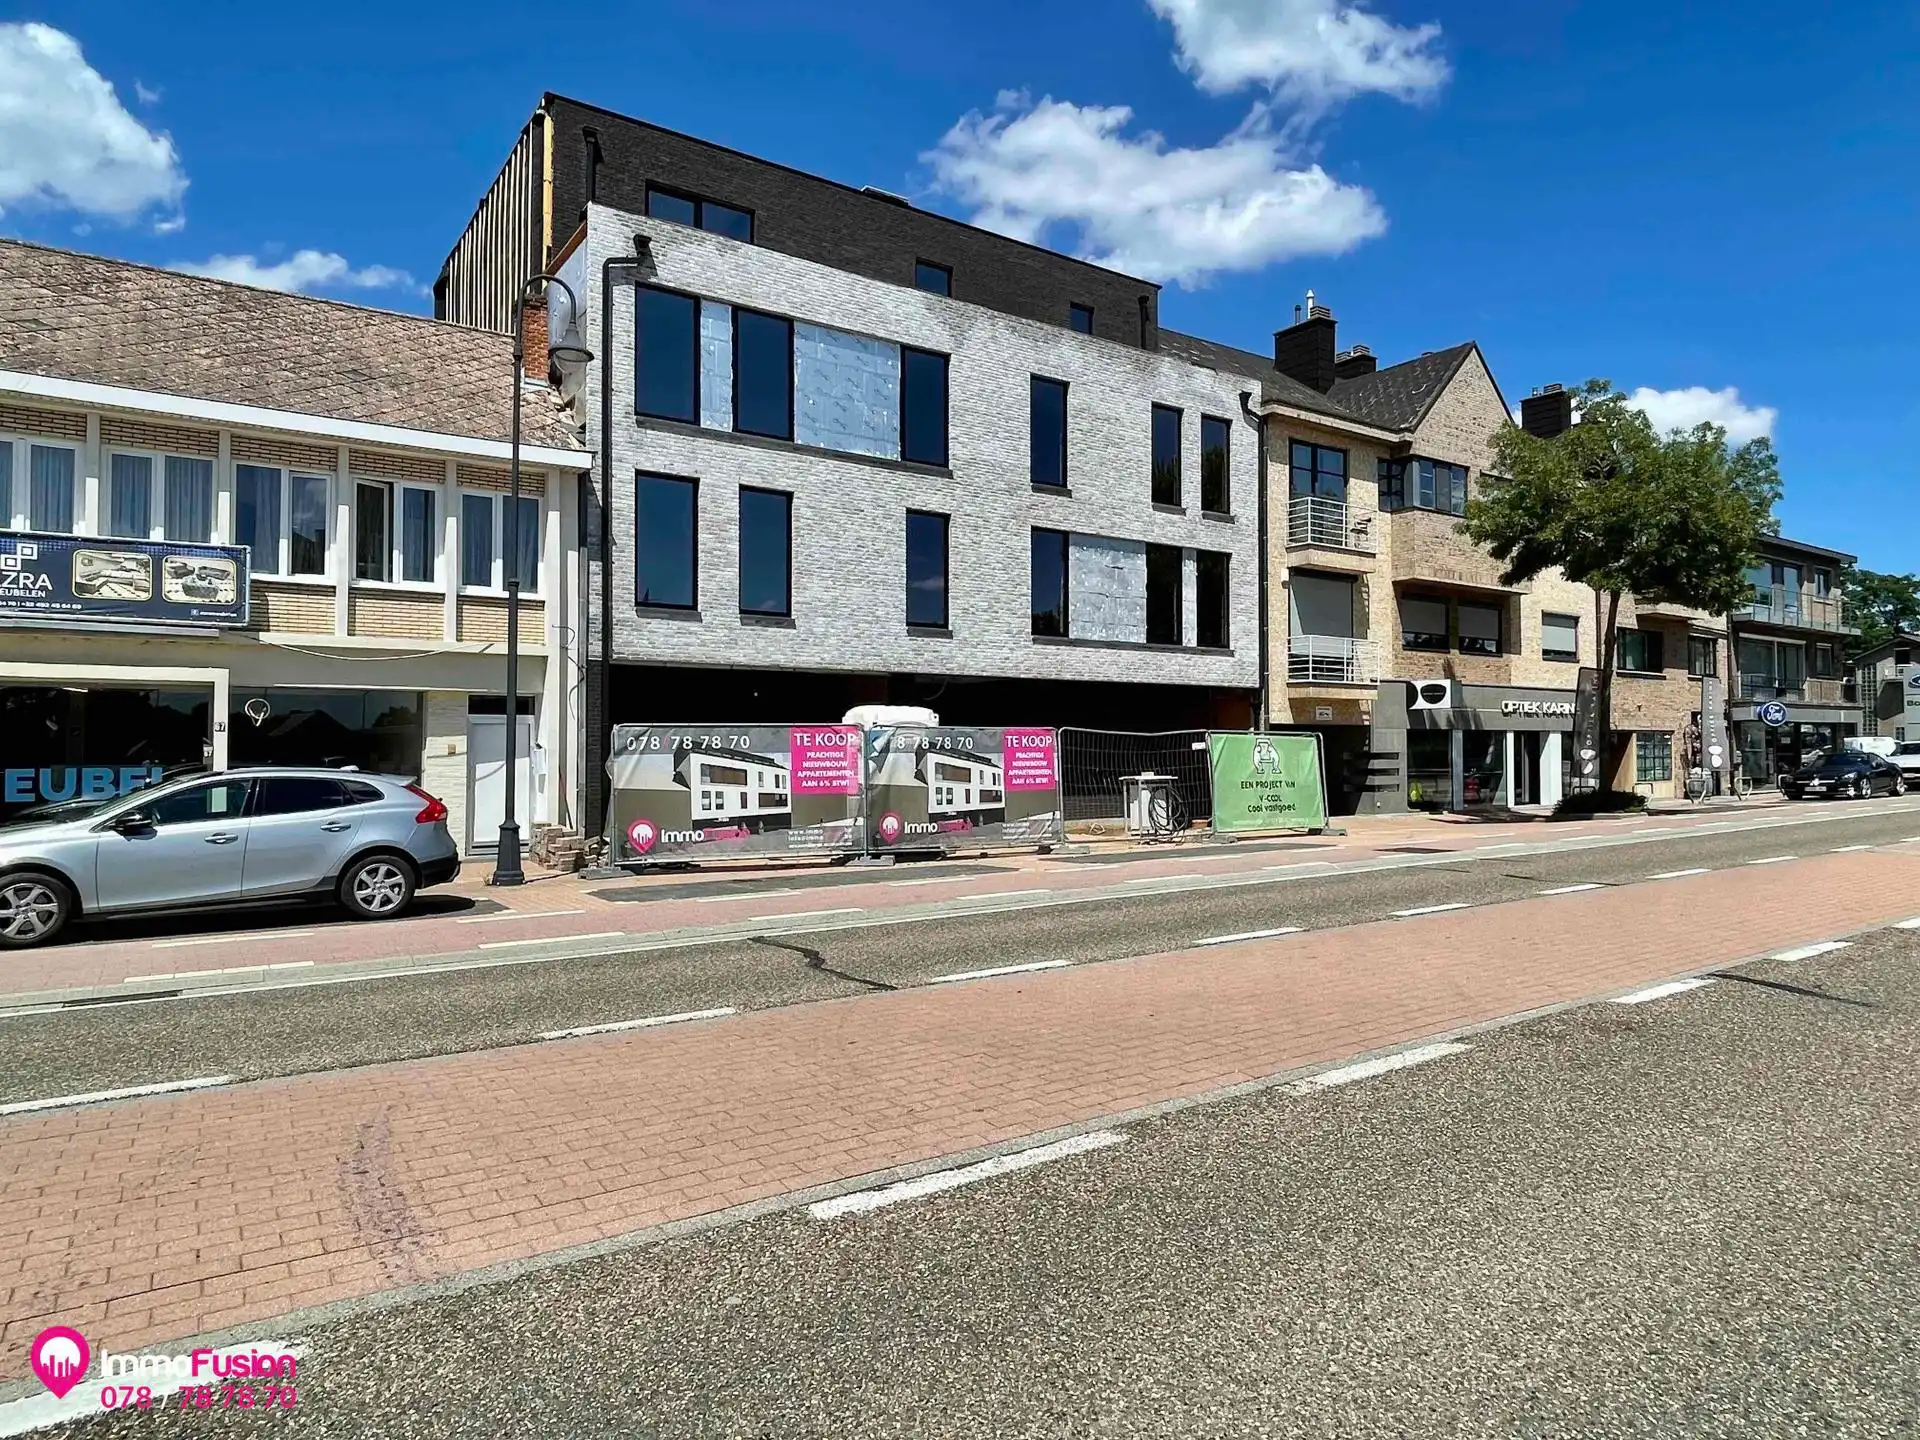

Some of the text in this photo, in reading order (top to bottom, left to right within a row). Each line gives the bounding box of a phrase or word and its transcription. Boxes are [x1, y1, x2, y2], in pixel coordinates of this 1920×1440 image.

[0, 571, 53, 590] ZRA
[626, 735, 660, 750] 078
[670, 736, 693, 750] 78
[700, 735, 722, 750] 78
[728, 735, 750, 749] 70
[794, 733, 857, 746] TE KOOP
[935, 736, 952, 749] 78
[957, 736, 974, 749] 70
[1005, 735, 1052, 748] TE KOOP
[1241, 781, 1254, 789] EEN
[1256, 781, 1282, 790] PROJECT
[1247, 804, 1263, 813] Cool
